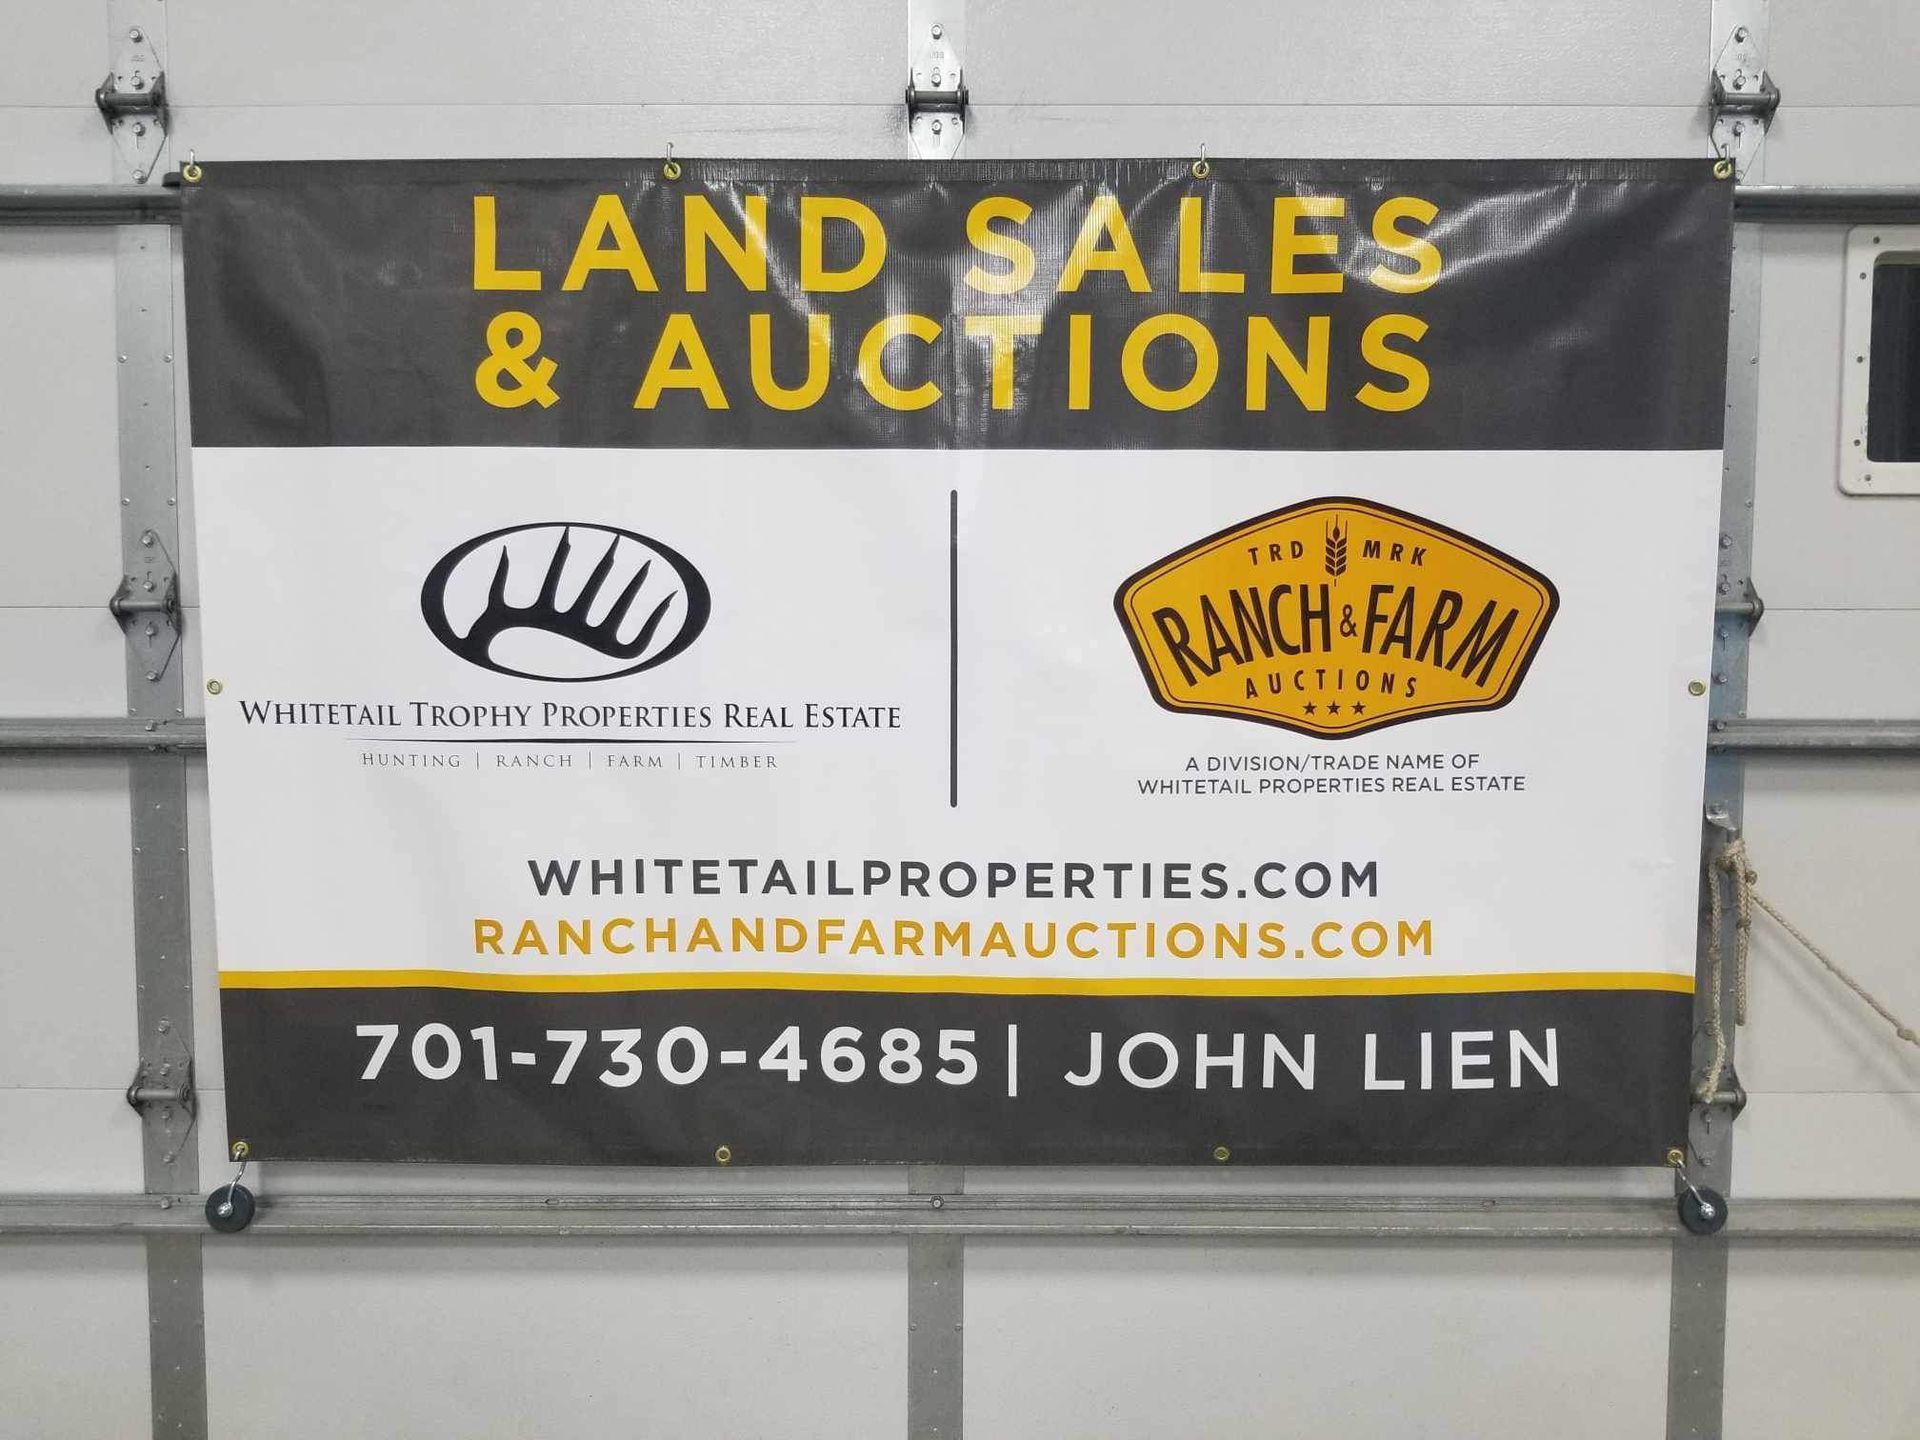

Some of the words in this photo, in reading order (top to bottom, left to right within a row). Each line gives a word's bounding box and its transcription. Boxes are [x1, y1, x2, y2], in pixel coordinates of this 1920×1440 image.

[473, 193, 887, 293] LAND
[966, 196, 1442, 294] SALES
[475, 311, 558, 408] &
[633, 313, 1430, 411] AUCTIONS
[1248, 541, 1303, 565] TRD
[1363, 540, 1426, 566] MRK
[1151, 584, 1332, 688] RANCH
[1340, 605, 1357, 637] &
[1361, 585, 1520, 688] FARM
[1247, 669, 1416, 699] AUCTIONS
[239, 701, 401, 725] WHITETAIL
[410, 702, 531, 726] TROPHY
[542, 703, 711, 727] PROPERTIES
[724, 704, 793, 727] REAL
[805, 704, 900, 728] ESTATE
[362, 753, 459, 767] HUNTING
[497, 755, 571, 767] RANCH
[608, 755, 661, 768] FARM
[696, 756, 776, 768] TIMBER
[1186, 757, 1199, 771] A
[1208, 755, 1378, 772] DIVISION/TRADE
[1387, 755, 1444, 769] NAME
[1452, 754, 1481, 769] OF
[1138, 780, 1251, 794] WHITETAIL
[1260, 778, 1384, 793] PROPERTIES
[1393, 777, 1444, 791] REAL
[1452, 777, 1525, 791] ESTATE
[528, 859, 1377, 899] WHITETAILPROPERTIES.COM
[474, 917, 1432, 959] RANCHANDFARMAUCTIONS.COM
[357, 1023, 977, 1087] 701-730-4685
[1065, 1032, 1314, 1089] JOHN
[1365, 1029, 1558, 1089] LIEN
